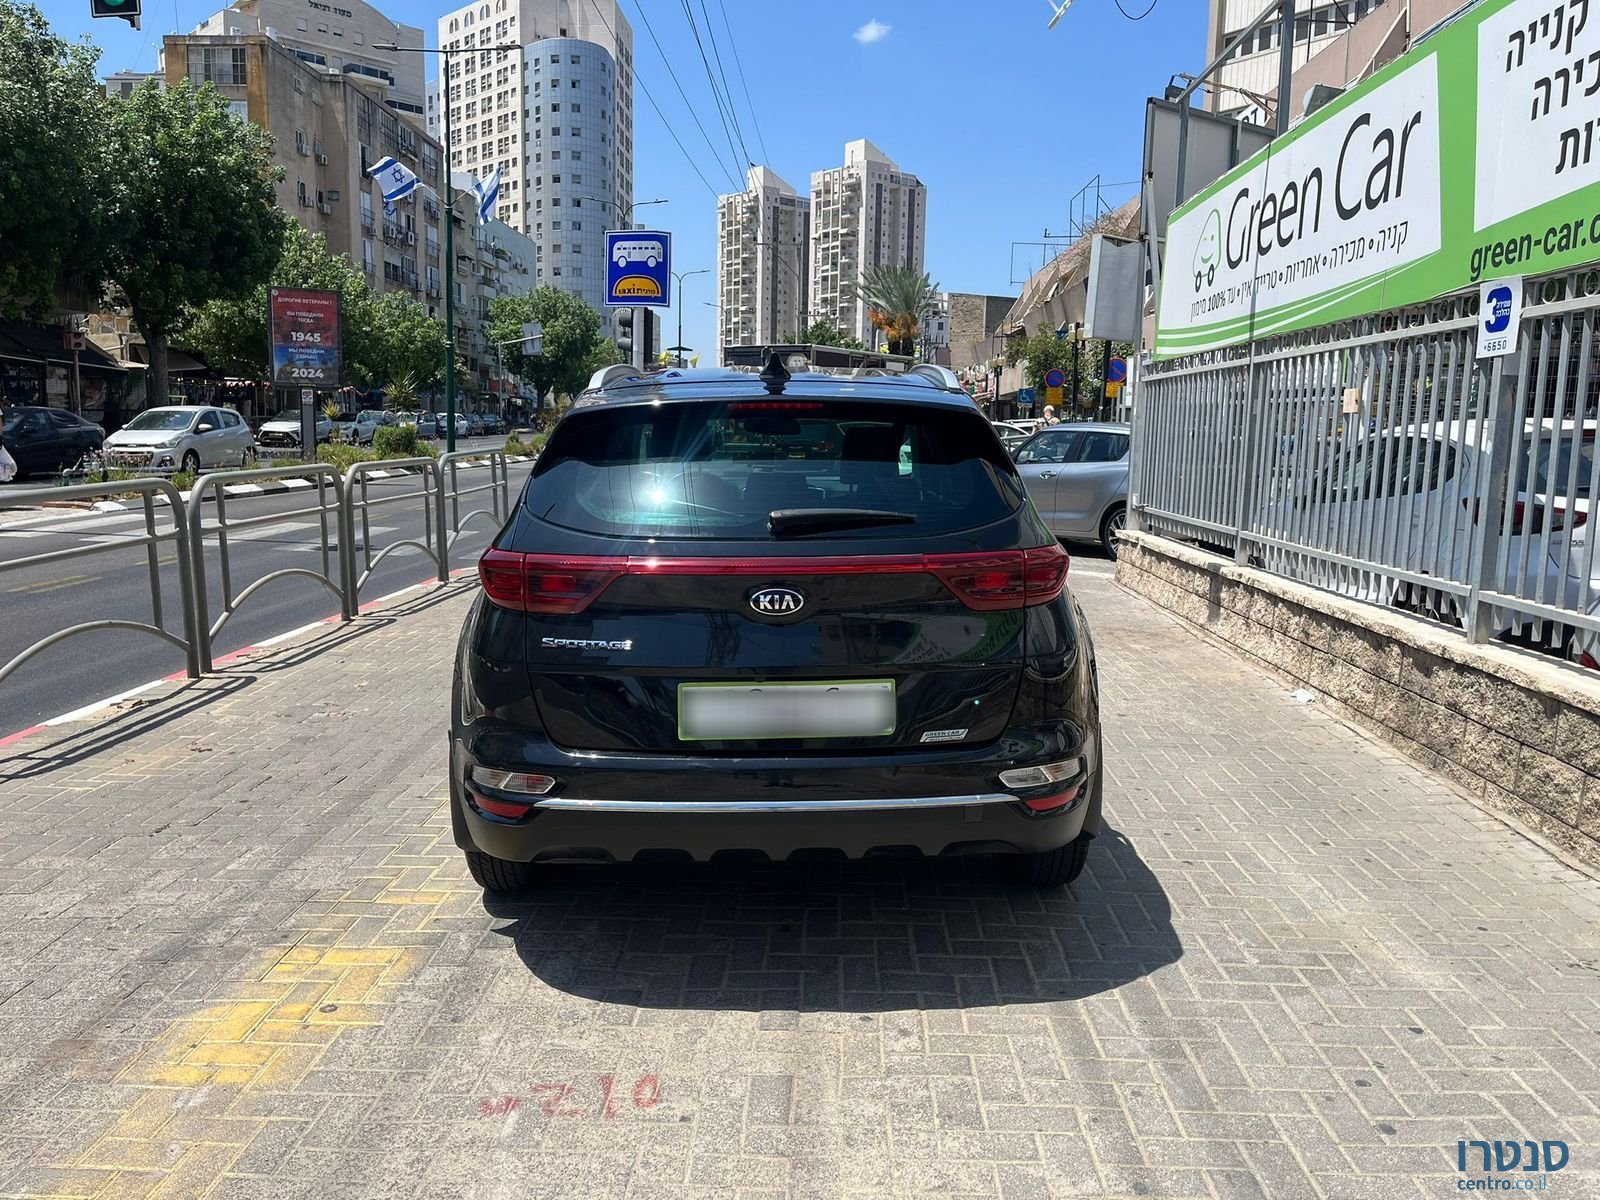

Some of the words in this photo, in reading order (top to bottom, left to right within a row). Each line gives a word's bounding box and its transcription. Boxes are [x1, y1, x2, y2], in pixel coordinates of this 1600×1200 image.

[1505, 0, 1590, 73] קנייה
[1226, 166, 1323, 270] Green
[1335, 110, 1422, 221] Car
[1376, 220, 1408, 254] קניה
[1329, 236, 1365, 269] מכירה
[1284, 253, 1321, 284] אחריות
[618, 283, 635, 295] taxi
[1207, 290, 1226, 312] 100%
[290, 331, 321, 343] 1945
[291, 368, 325, 378] 2024
[759, 593, 795, 611] KIA
[541, 636, 632, 651] SPORTAGE
